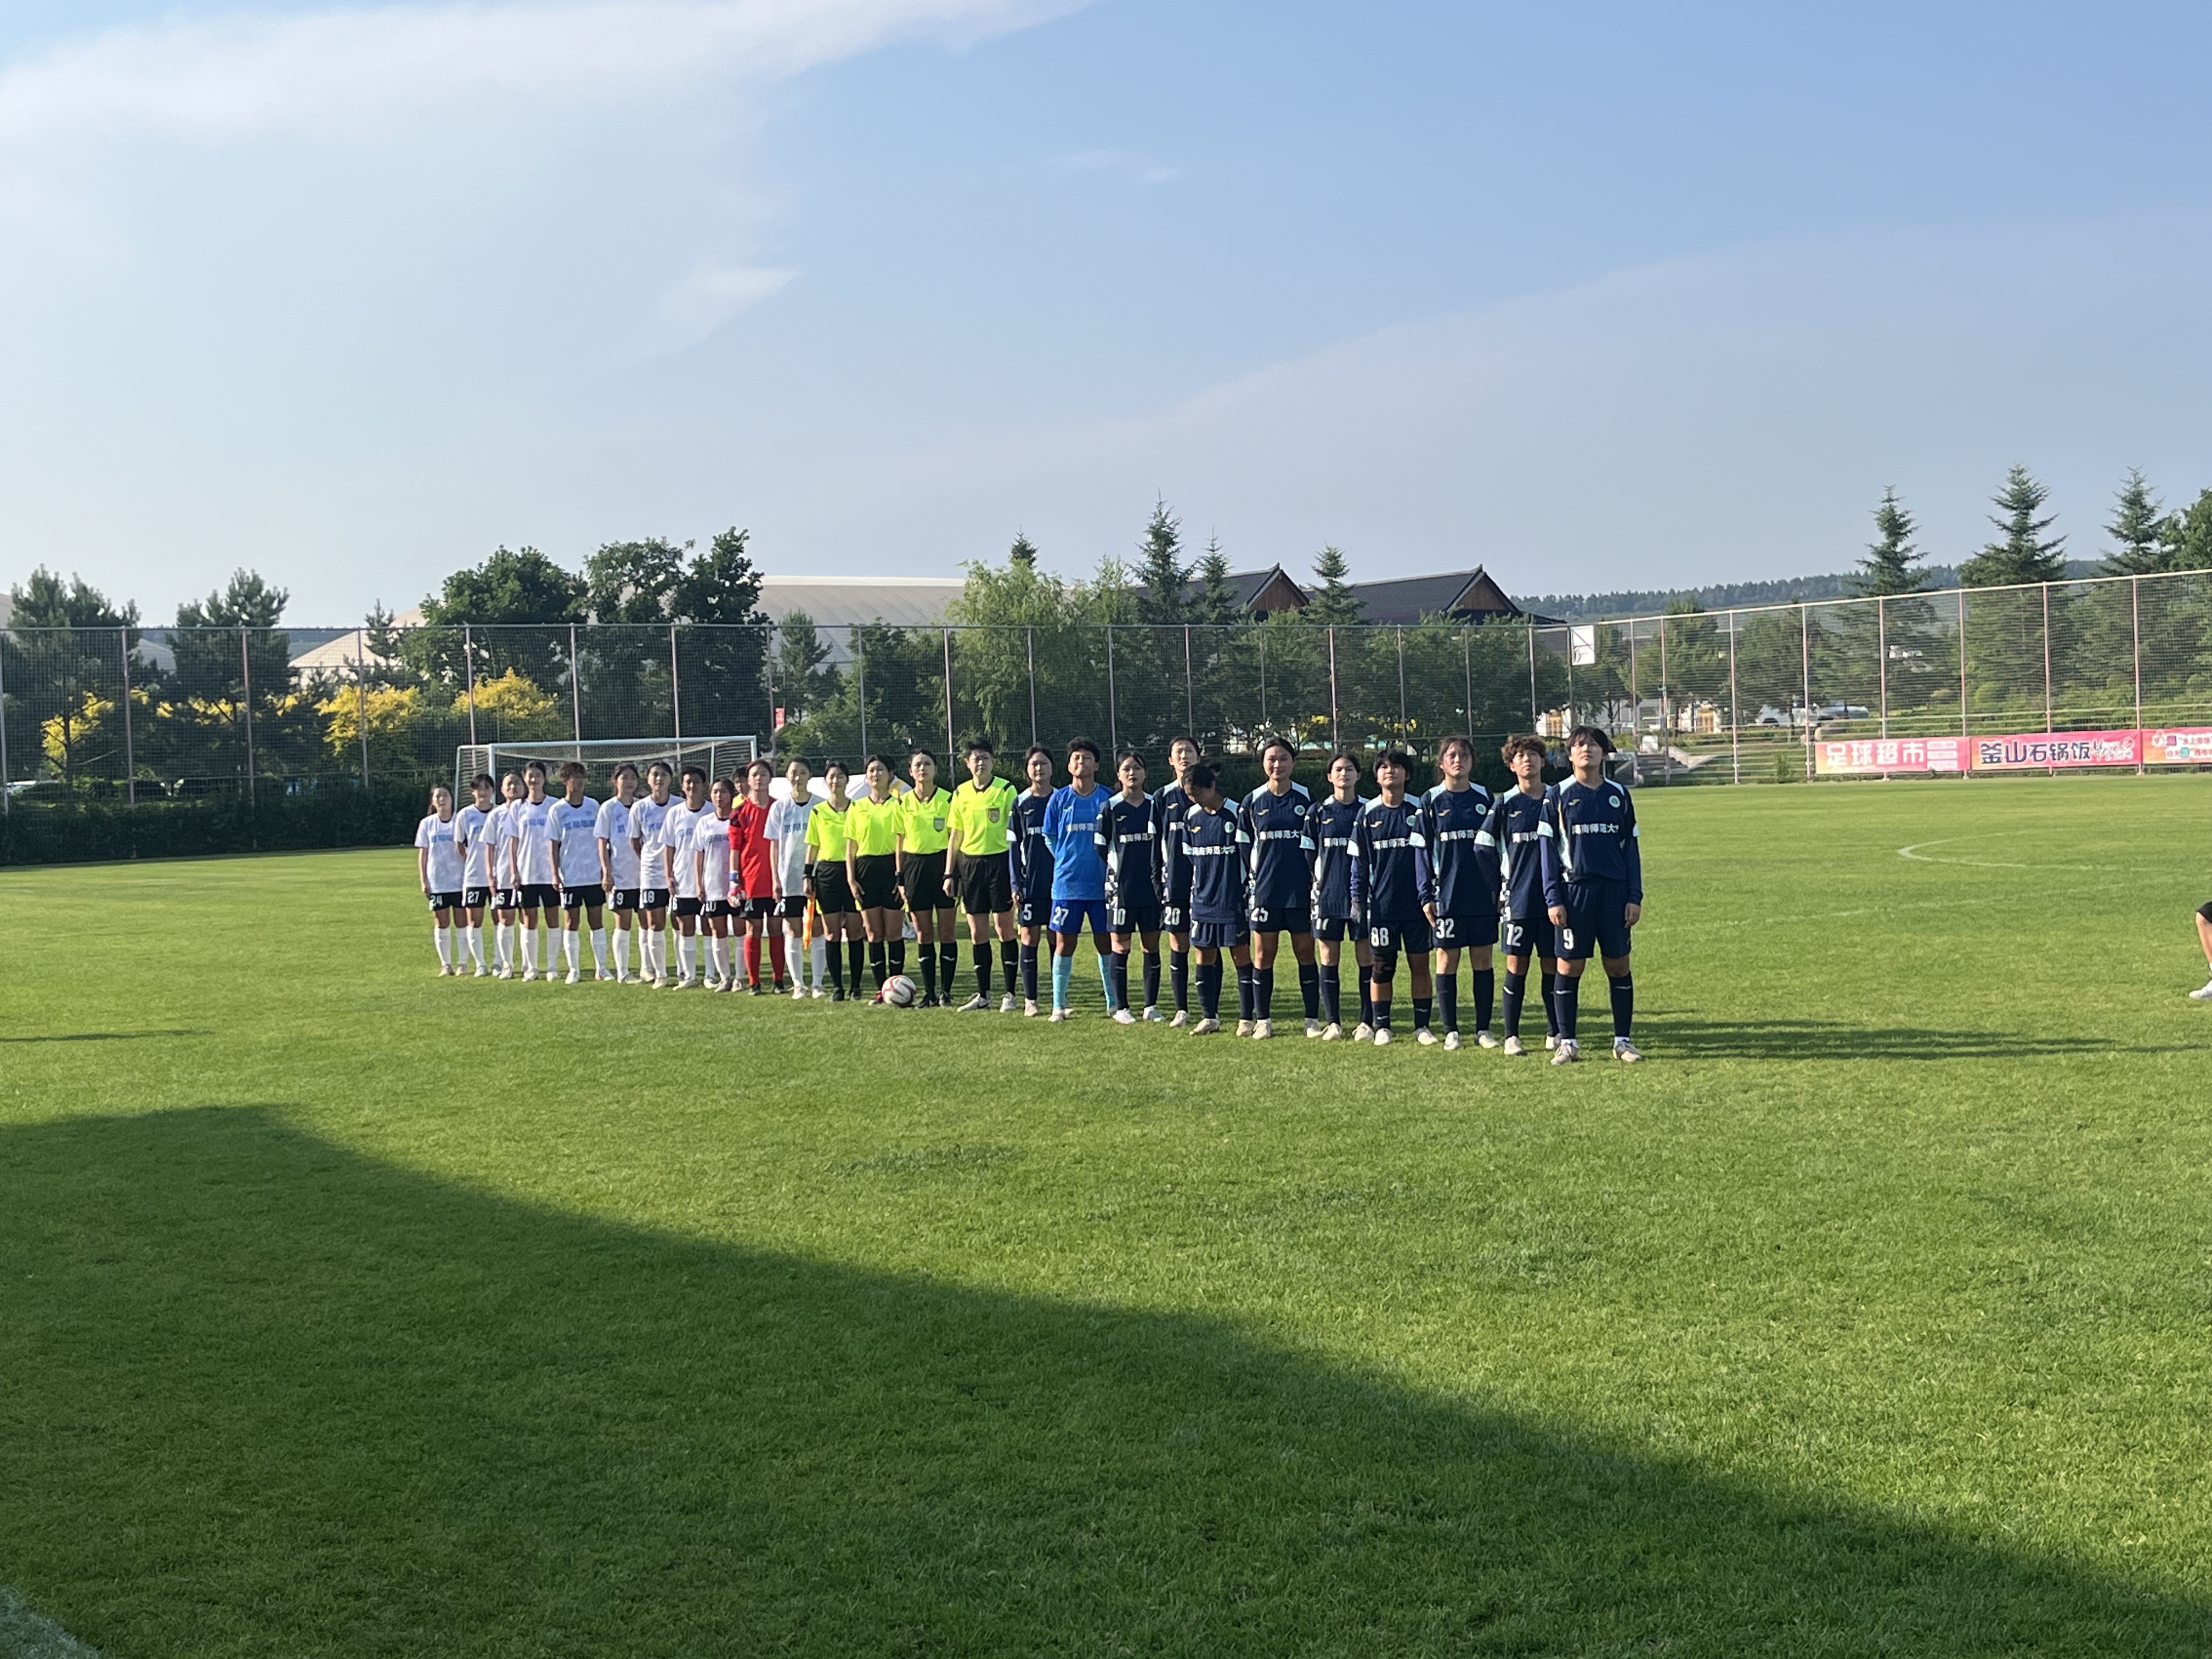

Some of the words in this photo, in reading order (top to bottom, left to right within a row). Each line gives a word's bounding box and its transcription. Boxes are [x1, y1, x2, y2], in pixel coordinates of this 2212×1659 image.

[1826, 741, 1924, 766] 足球超市
[1981, 741, 2091, 764] 釜山石锅饭
[468, 890, 479, 904] 27
[616, 892, 624, 905] 9
[1023, 903, 1032, 921] 5
[1052, 906, 1069, 926] 27
[1112, 908, 1126, 926] 10
[1164, 906, 1181, 925] 20
[1371, 927, 1390, 947] 88
[1435, 918, 1454, 938] 32
[1506, 923, 1523, 946] 12
[1562, 928, 1574, 950] 9
